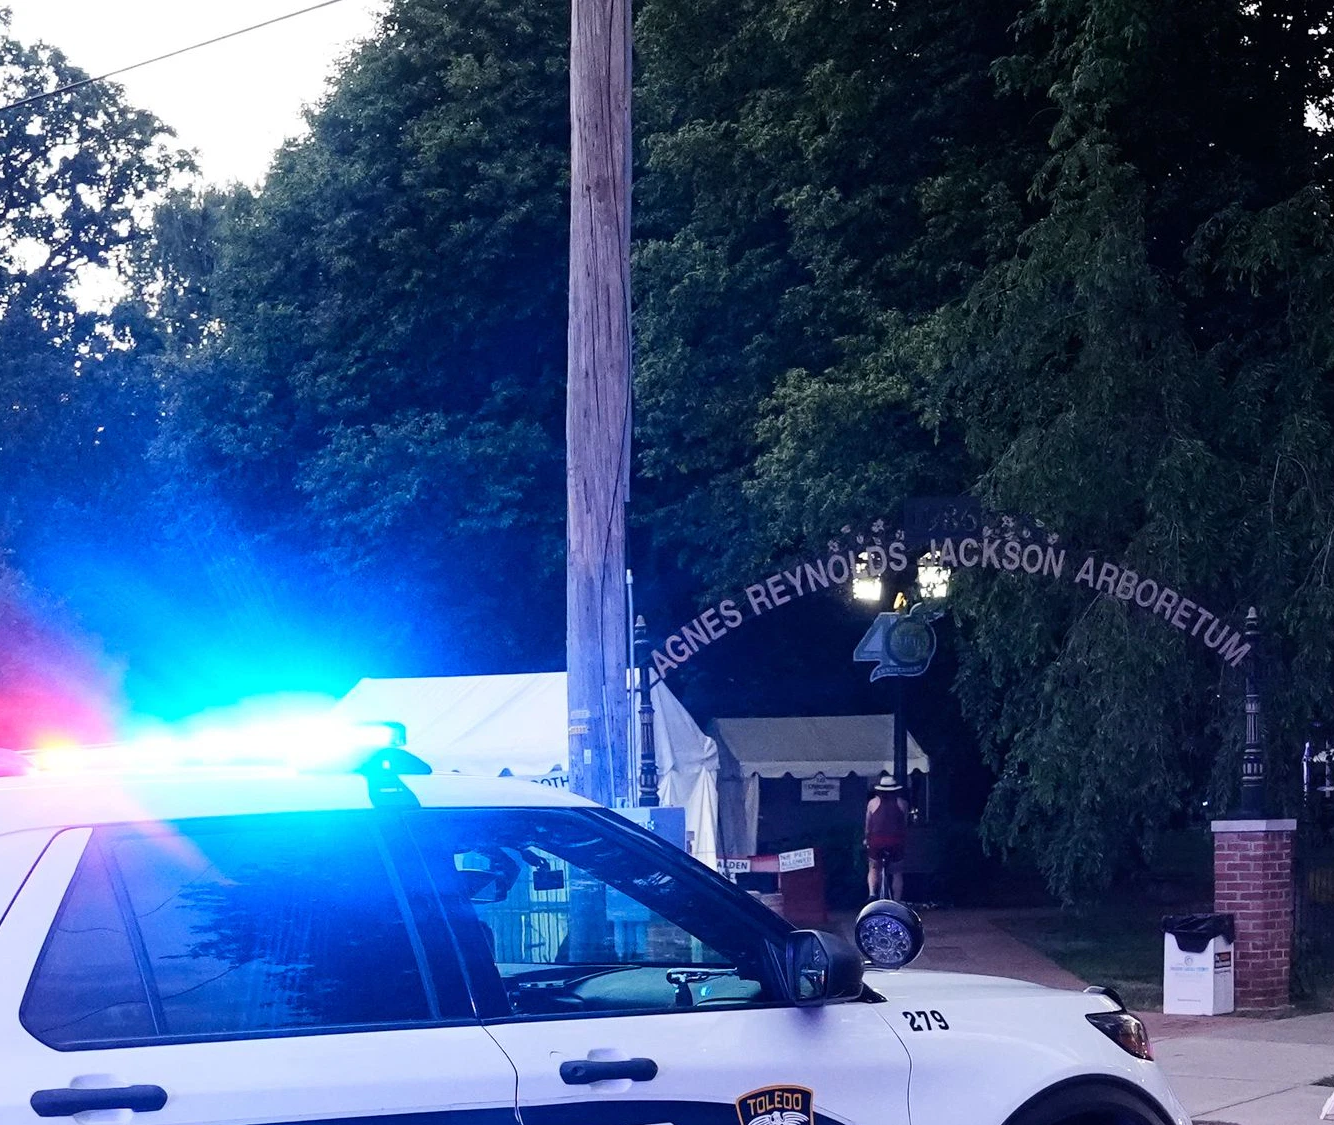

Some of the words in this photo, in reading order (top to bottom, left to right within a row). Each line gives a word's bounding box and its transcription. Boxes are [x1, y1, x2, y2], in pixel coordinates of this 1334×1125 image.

[651, 599, 743, 680] AGNES
[744, 541, 908, 616] REYNOLDS
[927, 537, 1067, 579] JACKSON
[1074, 557, 1252, 668] ARBORETUM
[901, 1009, 950, 1032] 279
[746, 1091, 802, 1116] TOLEDO
